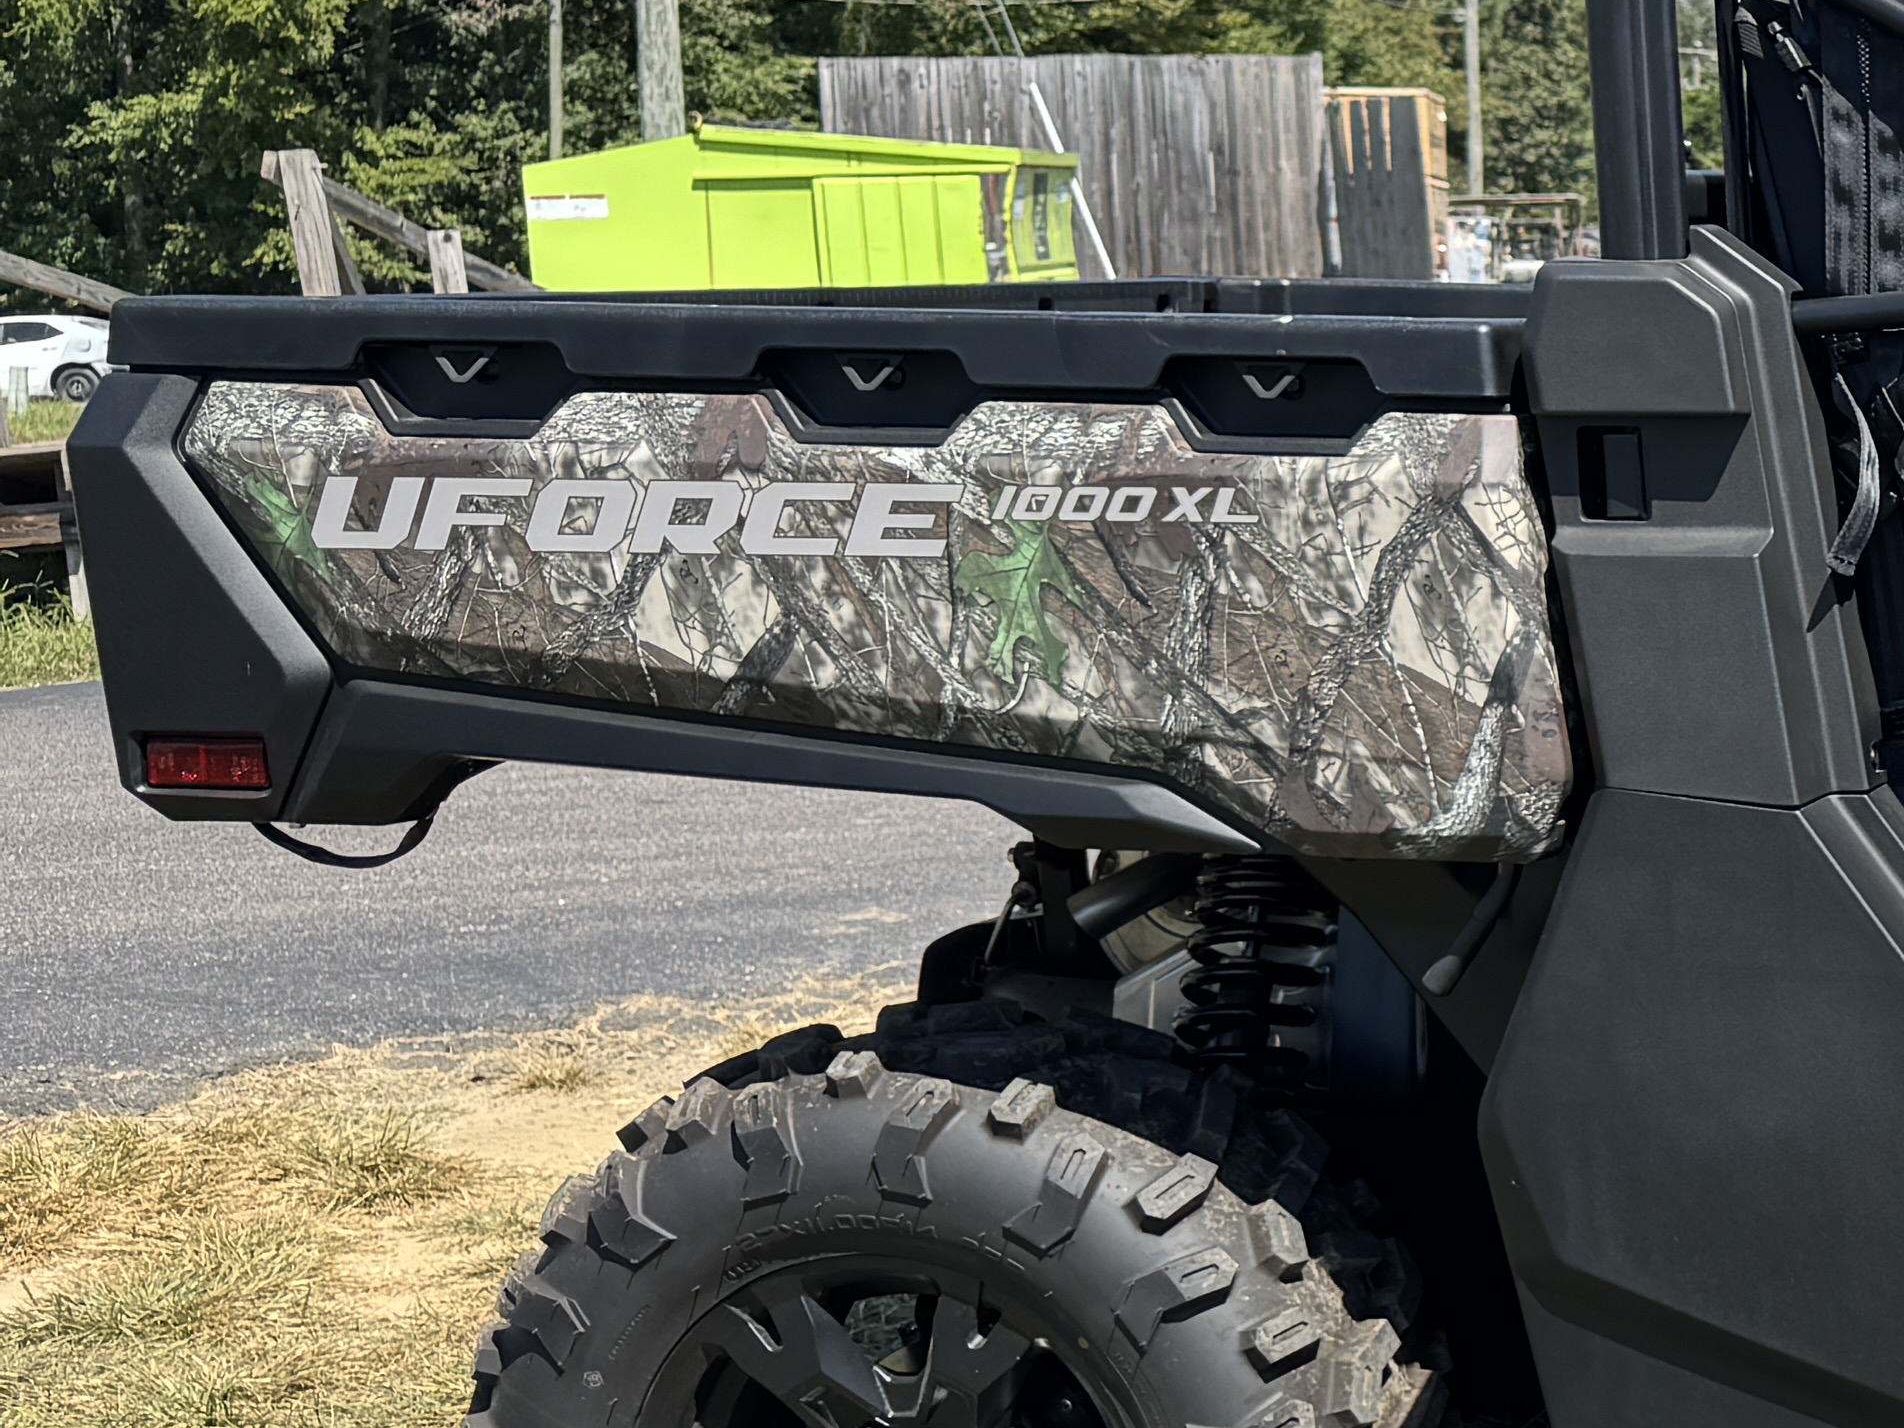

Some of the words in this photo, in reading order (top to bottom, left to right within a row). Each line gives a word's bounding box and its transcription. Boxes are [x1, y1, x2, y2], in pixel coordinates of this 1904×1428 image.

[311, 476, 964, 557] UFORCE
[991, 484, 1156, 524] 1000
[1161, 486, 1260, 525] XL
